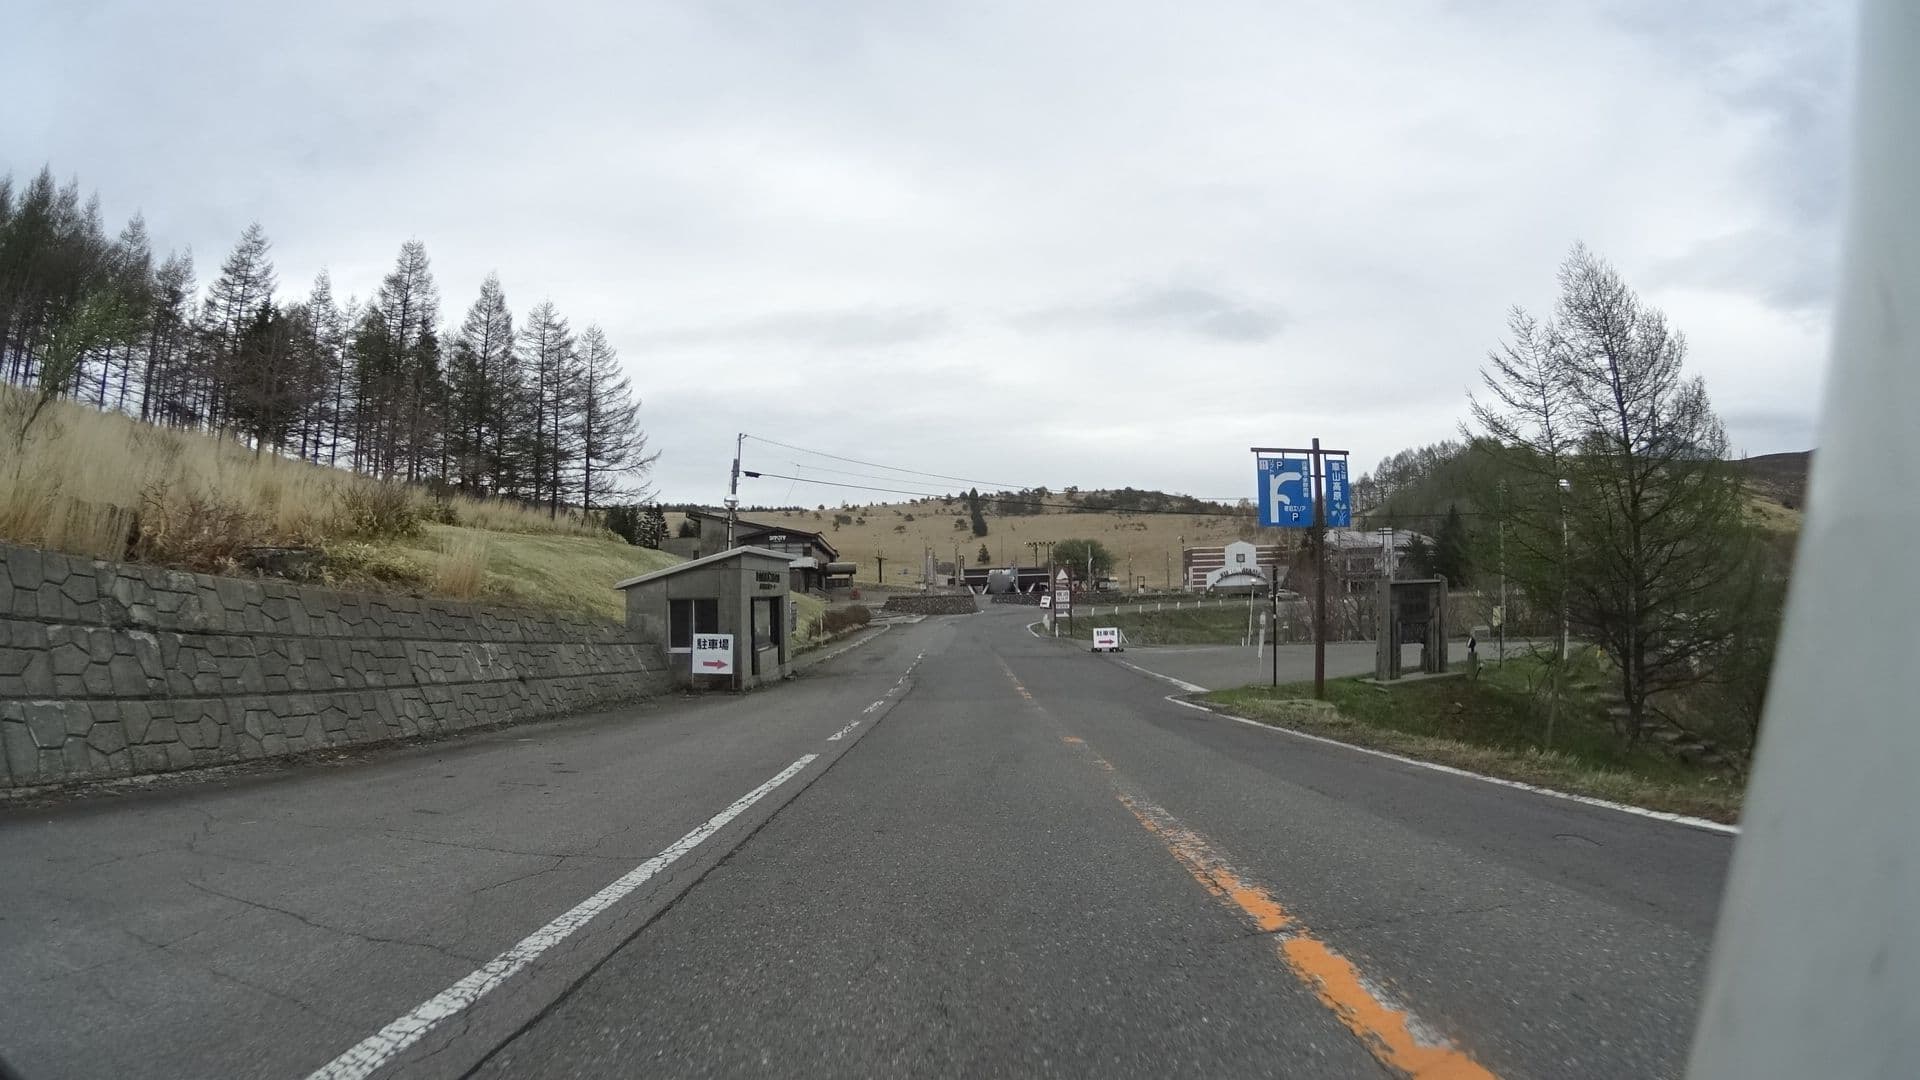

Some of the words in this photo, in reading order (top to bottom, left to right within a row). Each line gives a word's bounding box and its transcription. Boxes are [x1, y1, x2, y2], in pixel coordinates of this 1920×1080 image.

[1276, 461, 1283, 469] P
[1331, 462, 1341, 500] 車山高原
[1292, 512, 1299, 521] P
[697, 638, 729, 650] 駐車場
